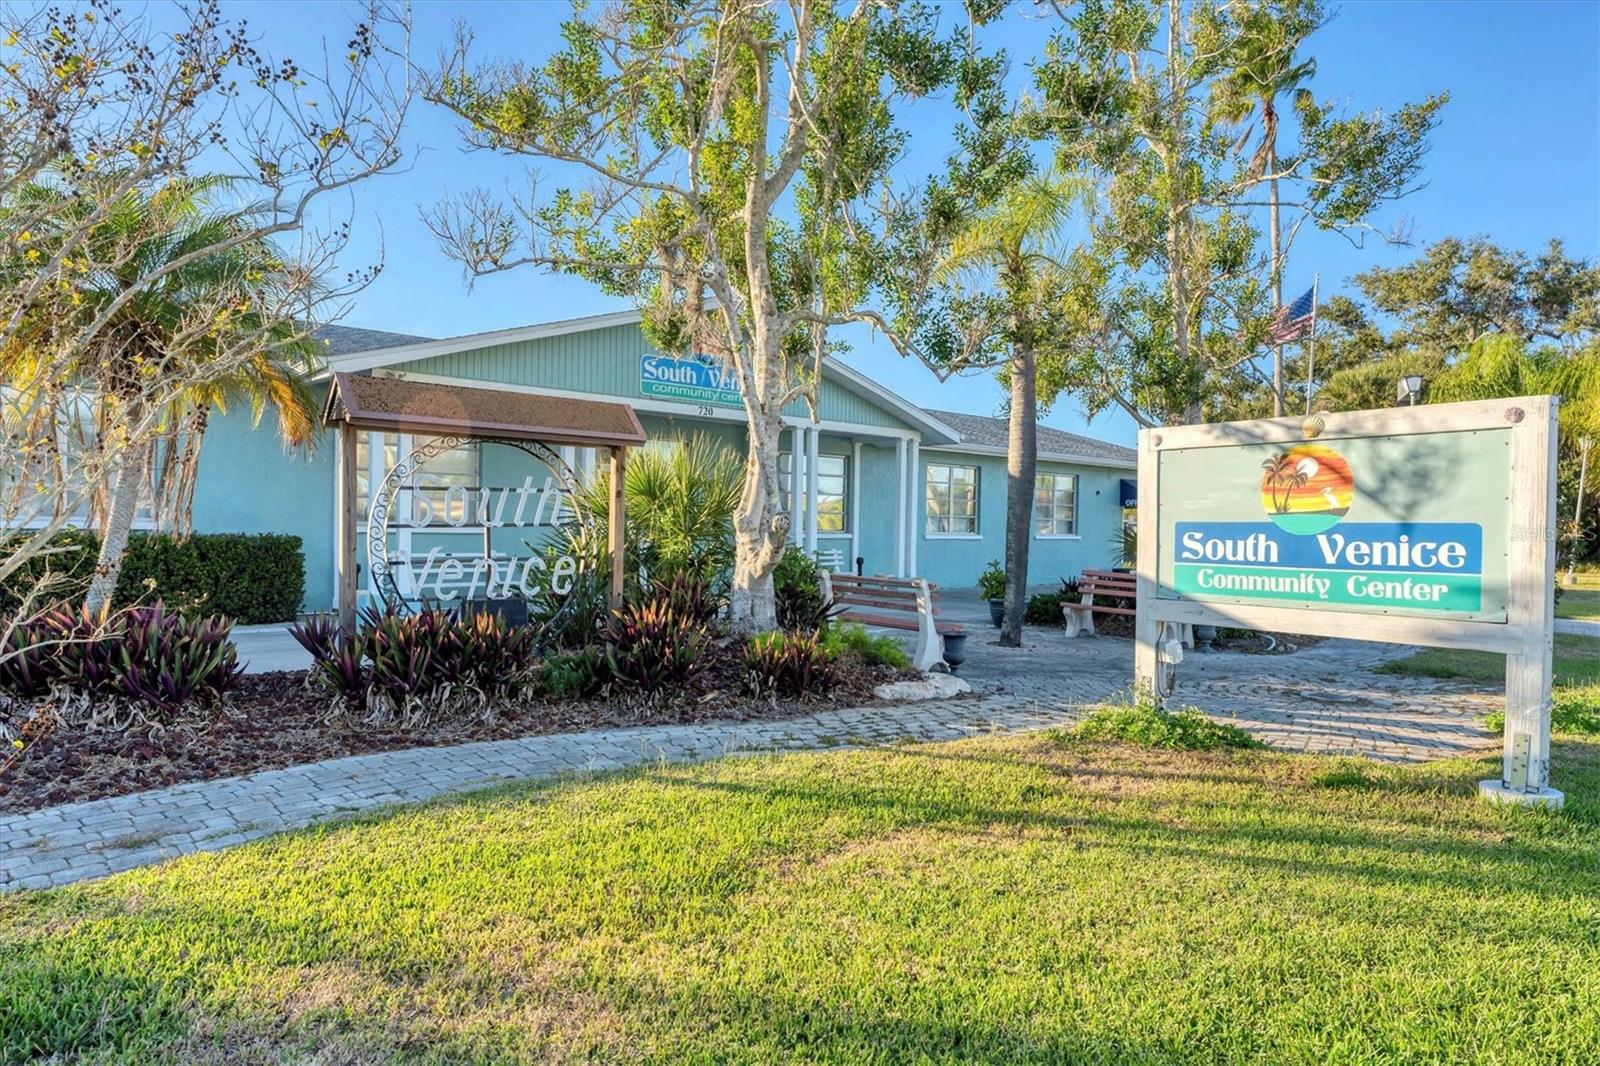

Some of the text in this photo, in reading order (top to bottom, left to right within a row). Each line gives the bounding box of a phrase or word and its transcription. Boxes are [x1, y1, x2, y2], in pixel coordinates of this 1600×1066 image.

[643, 359, 740, 391] South Ven
[652, 383, 742, 402] community cen
[698, 406, 714, 417] 720
[404, 474, 563, 528] South
[1181, 531, 1467, 568] South Venice
[396, 546, 577, 601] Venice
[1197, 568, 1449, 601] Community Center
